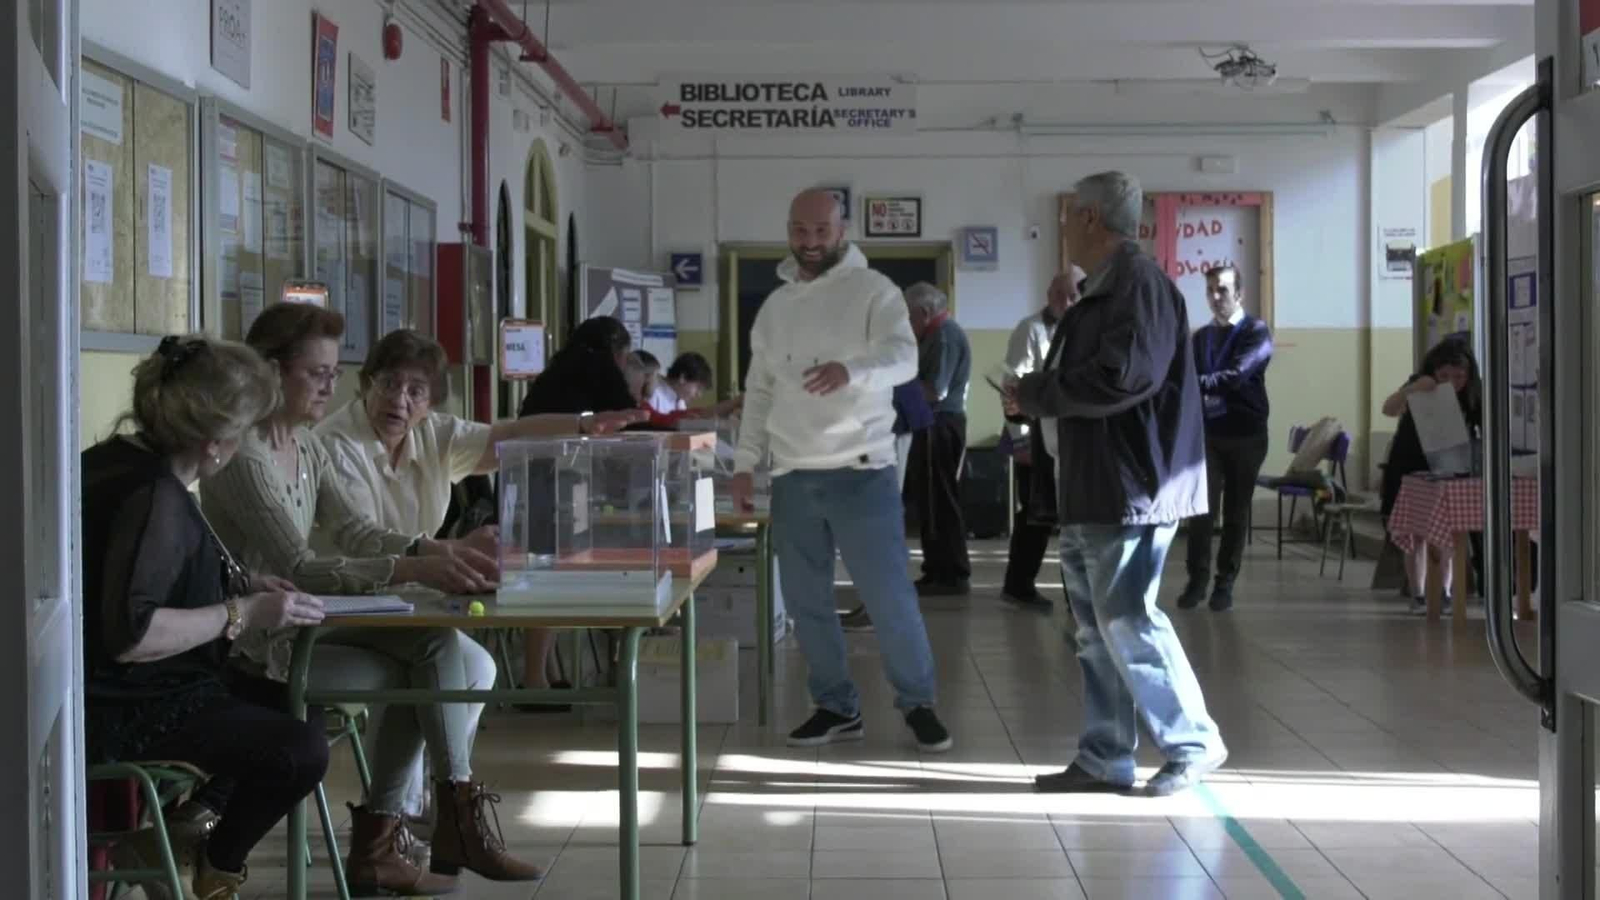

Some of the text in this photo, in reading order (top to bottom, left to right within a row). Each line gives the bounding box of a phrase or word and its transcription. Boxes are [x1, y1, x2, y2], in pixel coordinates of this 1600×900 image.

[680, 83, 828, 102] BIBLIOTECA
[838, 87, 891, 97] LIBRARY
[681, 106, 835, 128] SECRETARÍA
[848, 118, 891, 128] OFFICE
